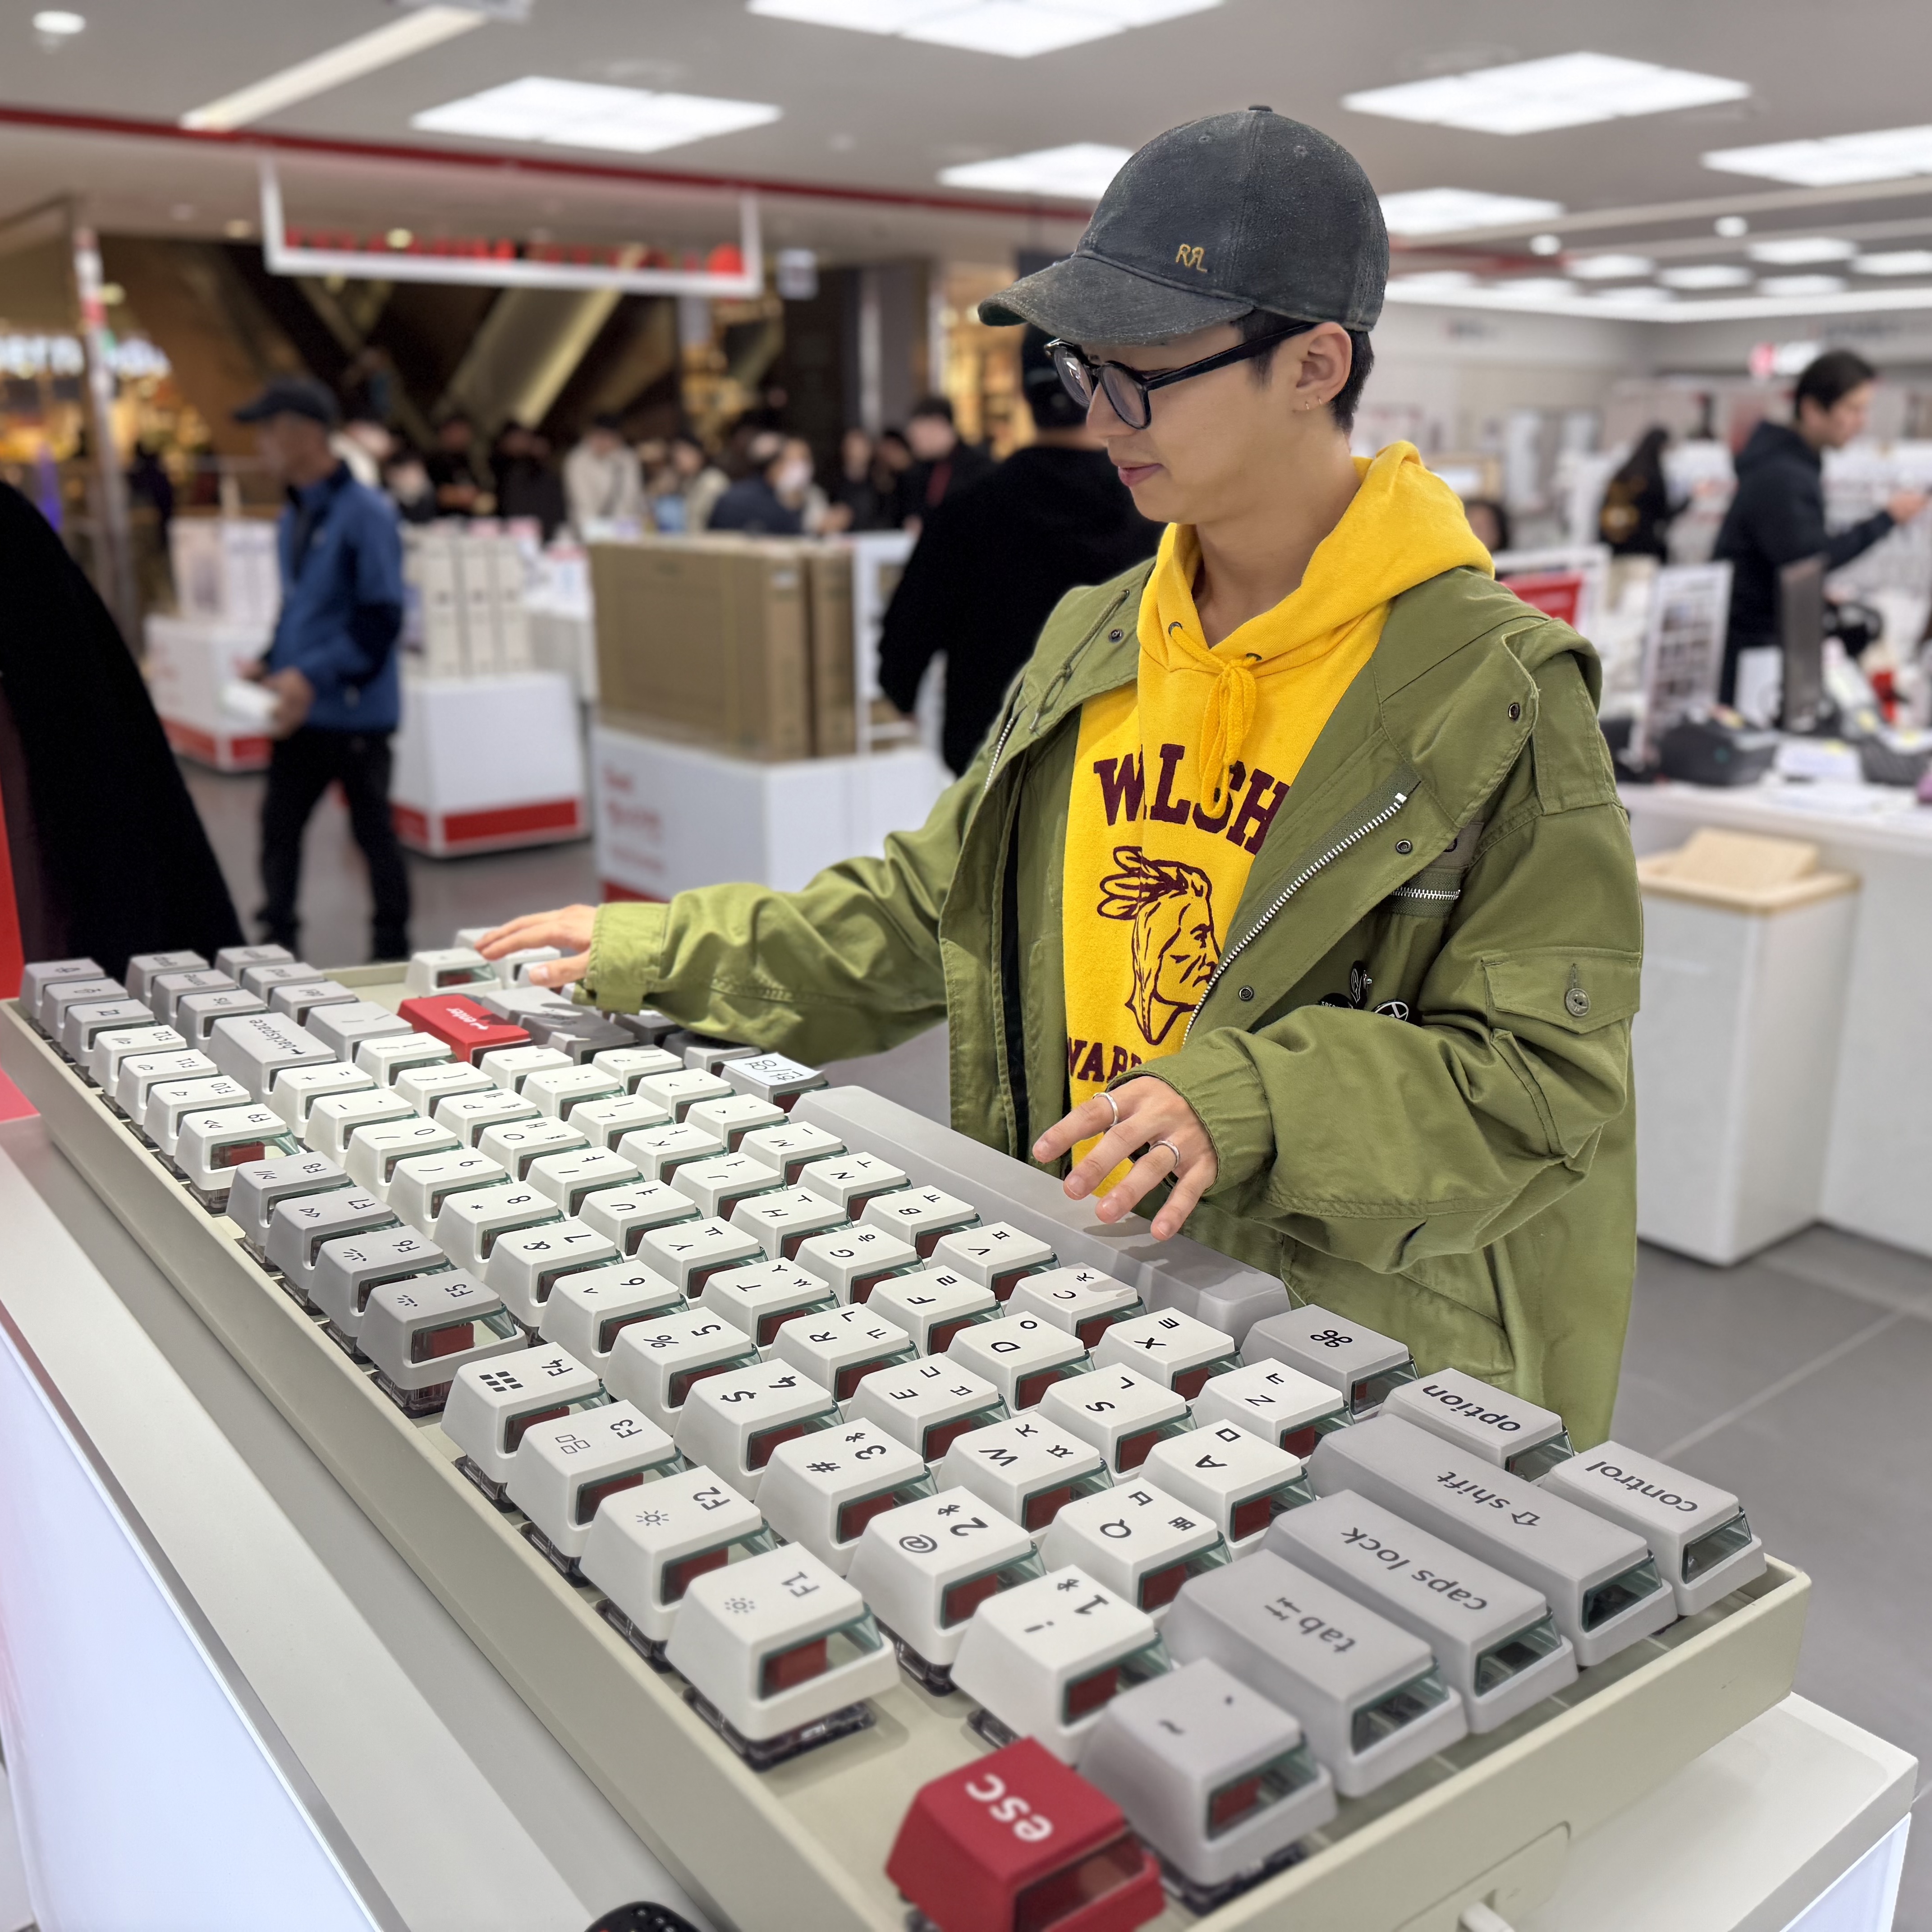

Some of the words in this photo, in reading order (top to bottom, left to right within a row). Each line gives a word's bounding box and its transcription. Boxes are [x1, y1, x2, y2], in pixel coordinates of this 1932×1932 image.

[446, 1008, 478, 1026] enter
[153, 1031, 176, 1041] F12
[249, 1019, 298, 1050] backspace
[176, 1058, 199, 1068] F11
[211, 1083, 235, 1094] F10
[247, 1113, 271, 1122] F9
[303, 1163, 327, 1173] F8
[348, 1199, 376, 1210] F7
[507, 1196, 532, 1204] 8
[923, 1194, 941, 1203] ㅠ
[762, 1209, 789, 1217] H
[705, 1227, 723, 1236] ㅛ
[992, 1231, 1010, 1240] ㅍ
[564, 1234, 592, 1243] 7
[858, 1234, 876, 1242] ㅎ
[392, 1240, 420, 1253] F6
[523, 1241, 551, 1250] &
[829, 1249, 854, 1257] G
[620, 1277, 645, 1286] 6
[793, 1279, 812, 1287] ㅆ
[936, 1275, 958, 1286] ㄹ
[1076, 1272, 1094, 1282] ㅊ
[444, 1284, 474, 1297] F5
[1053, 1290, 1076, 1299] C
[841, 1311, 855, 1322] ㄱ
[1020, 1320, 1037, 1329] ㅇ
[1158, 1318, 1180, 1329] ㅌ
[691, 1325, 721, 1336] 5
[809, 1331, 838, 1342] R
[866, 1329, 887, 1339] ㄲ
[643, 1335, 679, 1348] %
[991, 1342, 1021, 1353] D
[1134, 1337, 1167, 1349] X
[541, 1359, 574, 1377] F4
[920, 1366, 941, 1378] ㄷ
[768, 1375, 797, 1389] 4
[1120, 1376, 1135, 1389] ㄴ
[1265, 1373, 1285, 1385] ㅋ
[889, 1389, 919, 1400] E
[950, 1385, 973, 1396] ㄸ
[720, 1391, 757, 1403] $
[1244, 1394, 1276, 1407] Z
[1085, 1402, 1115, 1412] S
[1422, 1384, 1522, 1434] option
[610, 1419, 643, 1439] F3
[1015, 1424, 1038, 1437] ㅈ
[1215, 1428, 1241, 1442] ㅁ
[855, 1445, 886, 1460] 3
[1046, 1444, 1074, 1458] ㅉ
[978, 1449, 1019, 1467] W
[1195, 1454, 1228, 1468] A
[806, 1462, 841, 1473] #
[1437, 1471, 1511, 1510] shift
[1585, 1460, 1698, 1513] control
[693, 1484, 733, 1511] F2
[1128, 1491, 1154, 1506] ㅂ
[950, 1517, 989, 1536] 2
[1100, 1518, 1132, 1539] Q
[1168, 1516, 1197, 1531] ㅃ
[899, 1534, 938, 1554] @
[1340, 1527, 1410, 1572] lock
[781, 1571, 820, 1597] F1
[1411, 1571, 1488, 1610] caps
[1074, 1594, 1109, 1615] 1
[1024, 1621, 1054, 1633] !
[1298, 1615, 1356, 1653] tab
[966, 1774, 1052, 1841] esc
